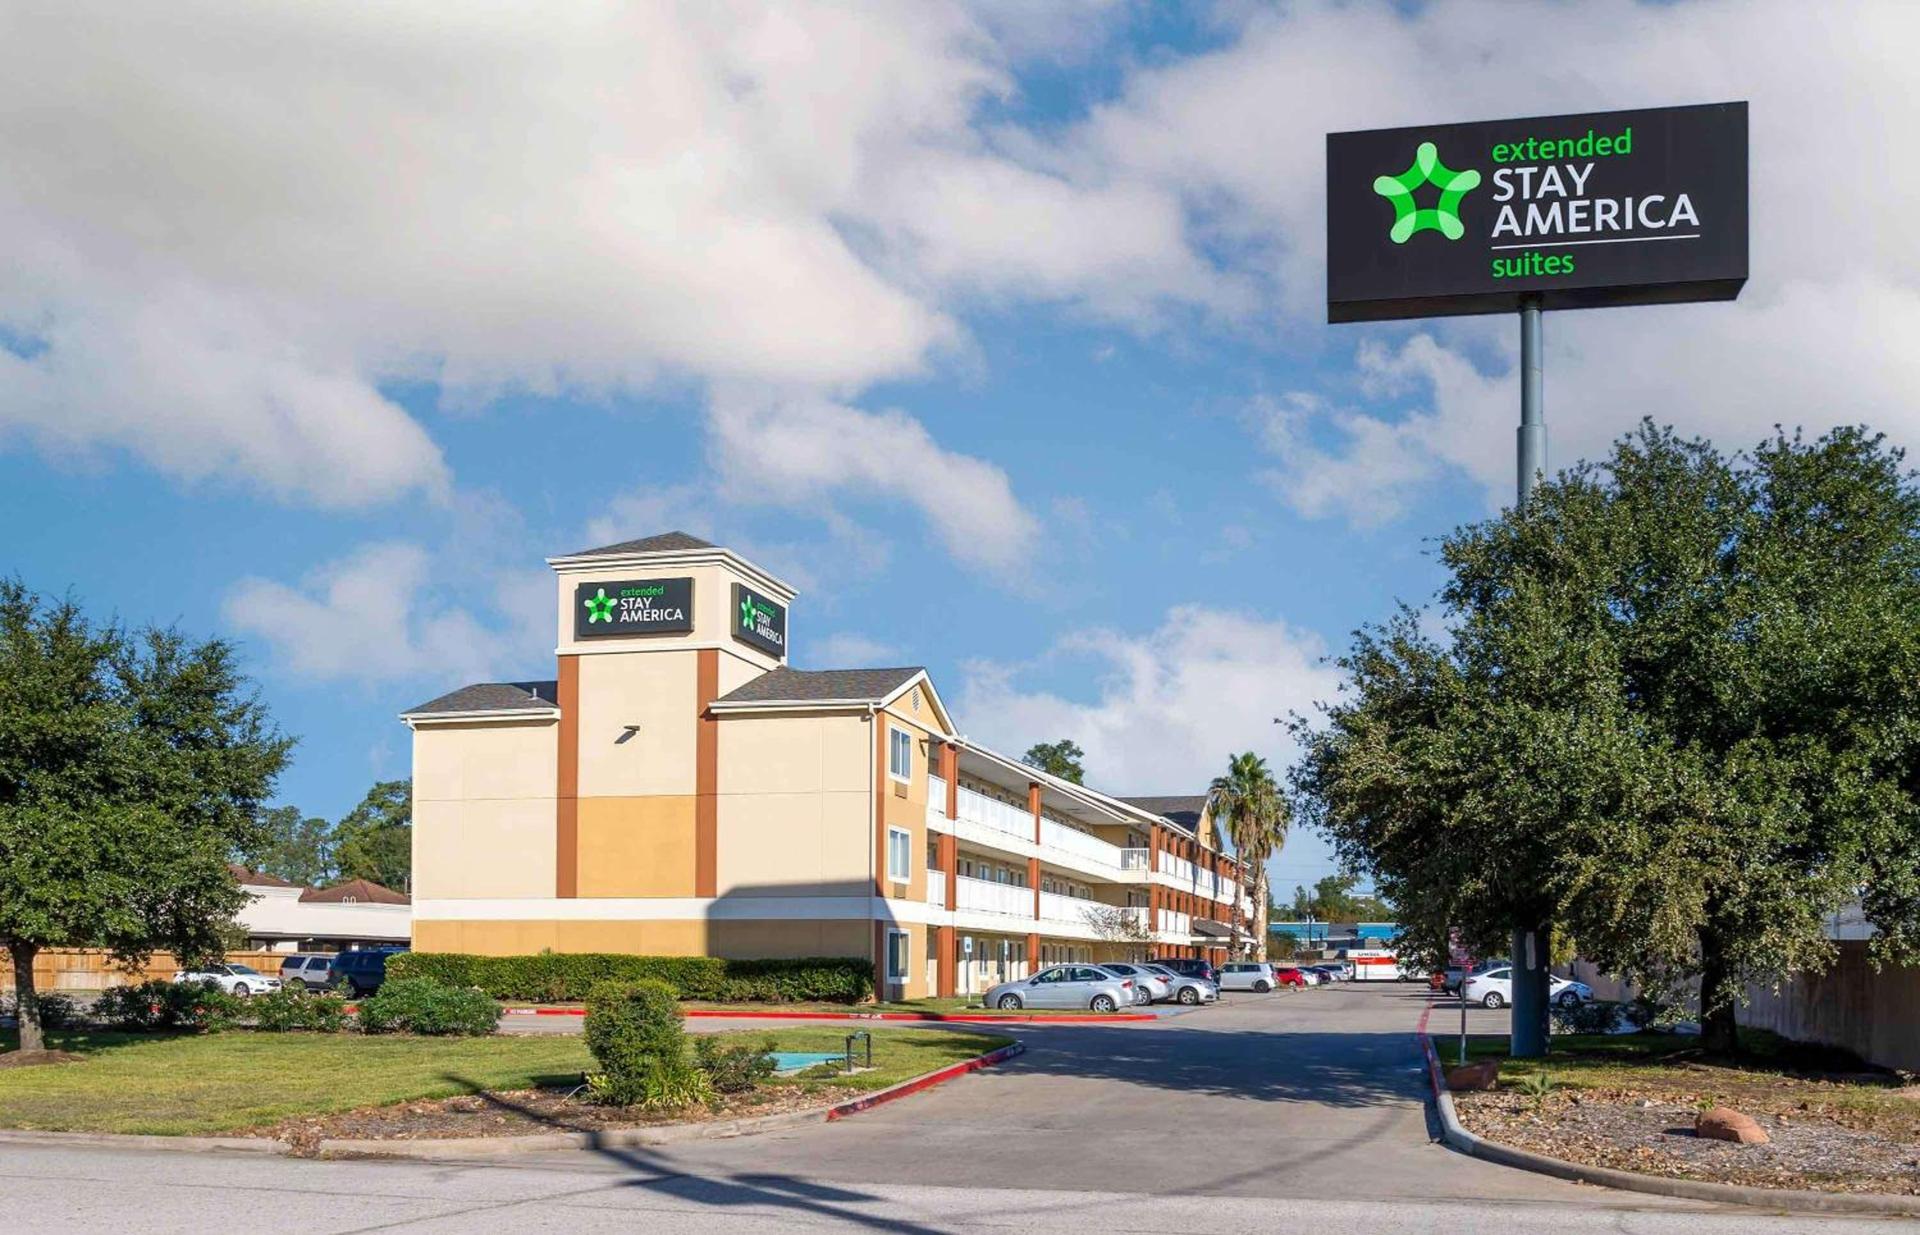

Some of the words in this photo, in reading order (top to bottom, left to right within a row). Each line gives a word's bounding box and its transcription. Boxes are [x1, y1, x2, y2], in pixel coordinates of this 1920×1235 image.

[1491, 127, 1632, 164] extended
[1492, 163, 1595, 202] STAY
[1491, 193, 1700, 238] AMERICA
[1491, 251, 1575, 278] suites
[620, 585, 665, 597] extended
[620, 597, 653, 610] STAY
[620, 608, 684, 622] AMERICA
